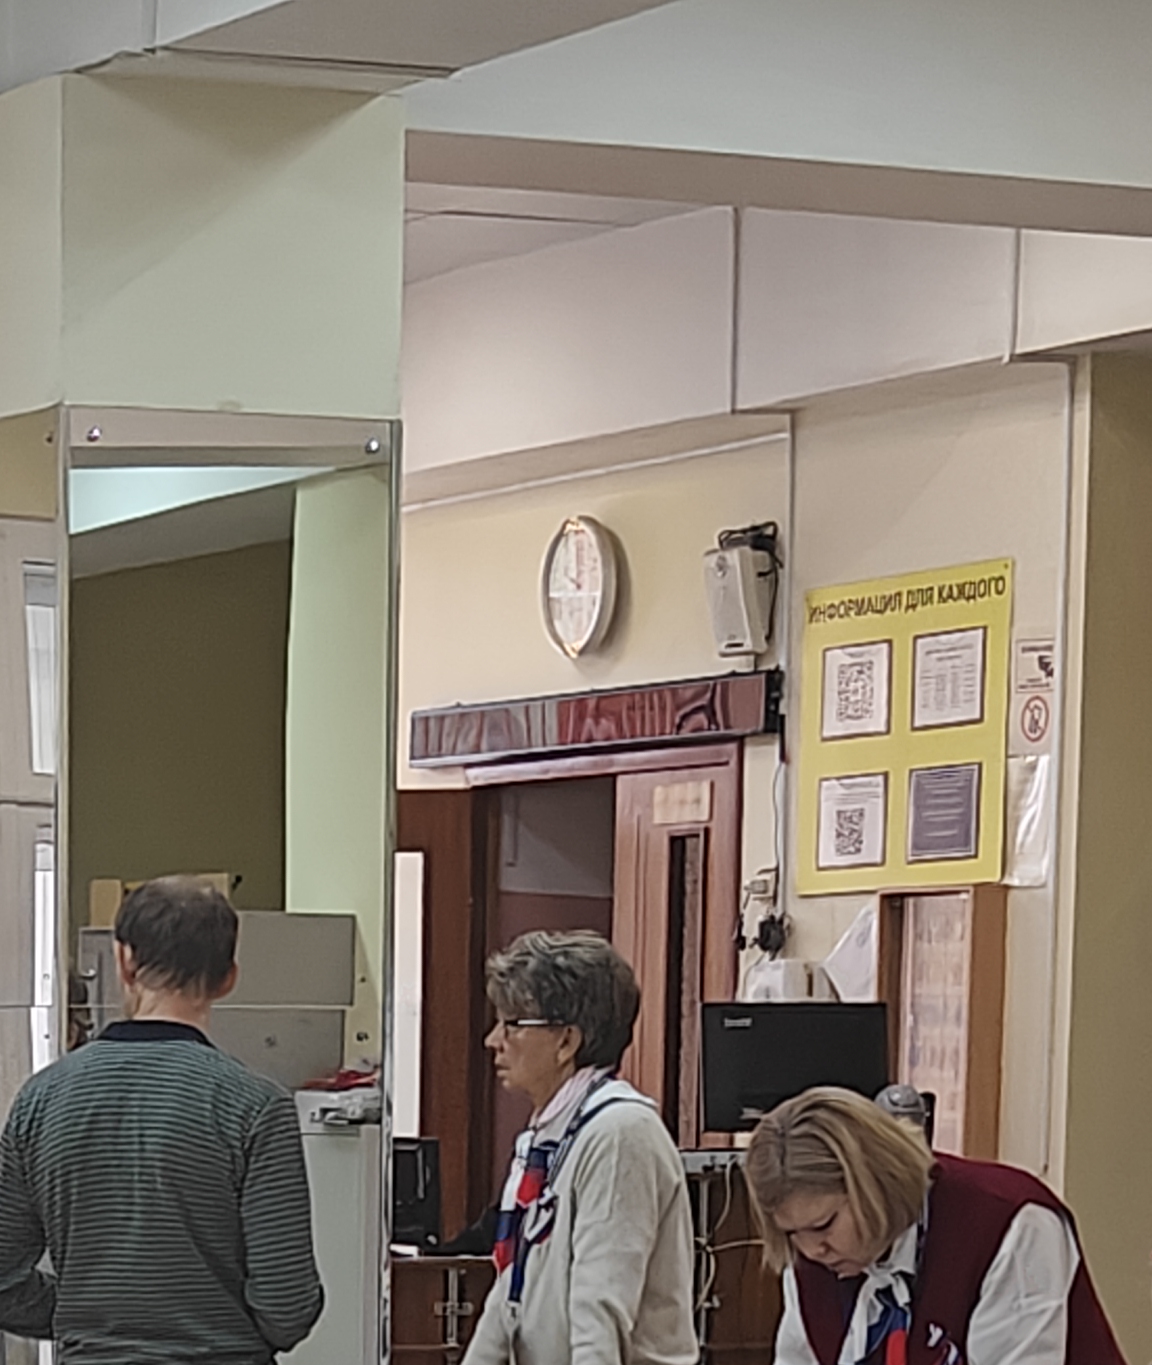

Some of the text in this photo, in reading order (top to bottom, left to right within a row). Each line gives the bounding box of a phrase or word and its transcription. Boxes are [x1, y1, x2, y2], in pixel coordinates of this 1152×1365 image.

[808, 575, 1006, 625] ИНФОРМАЦИЯ ДЛЯ КАЖДОГО
